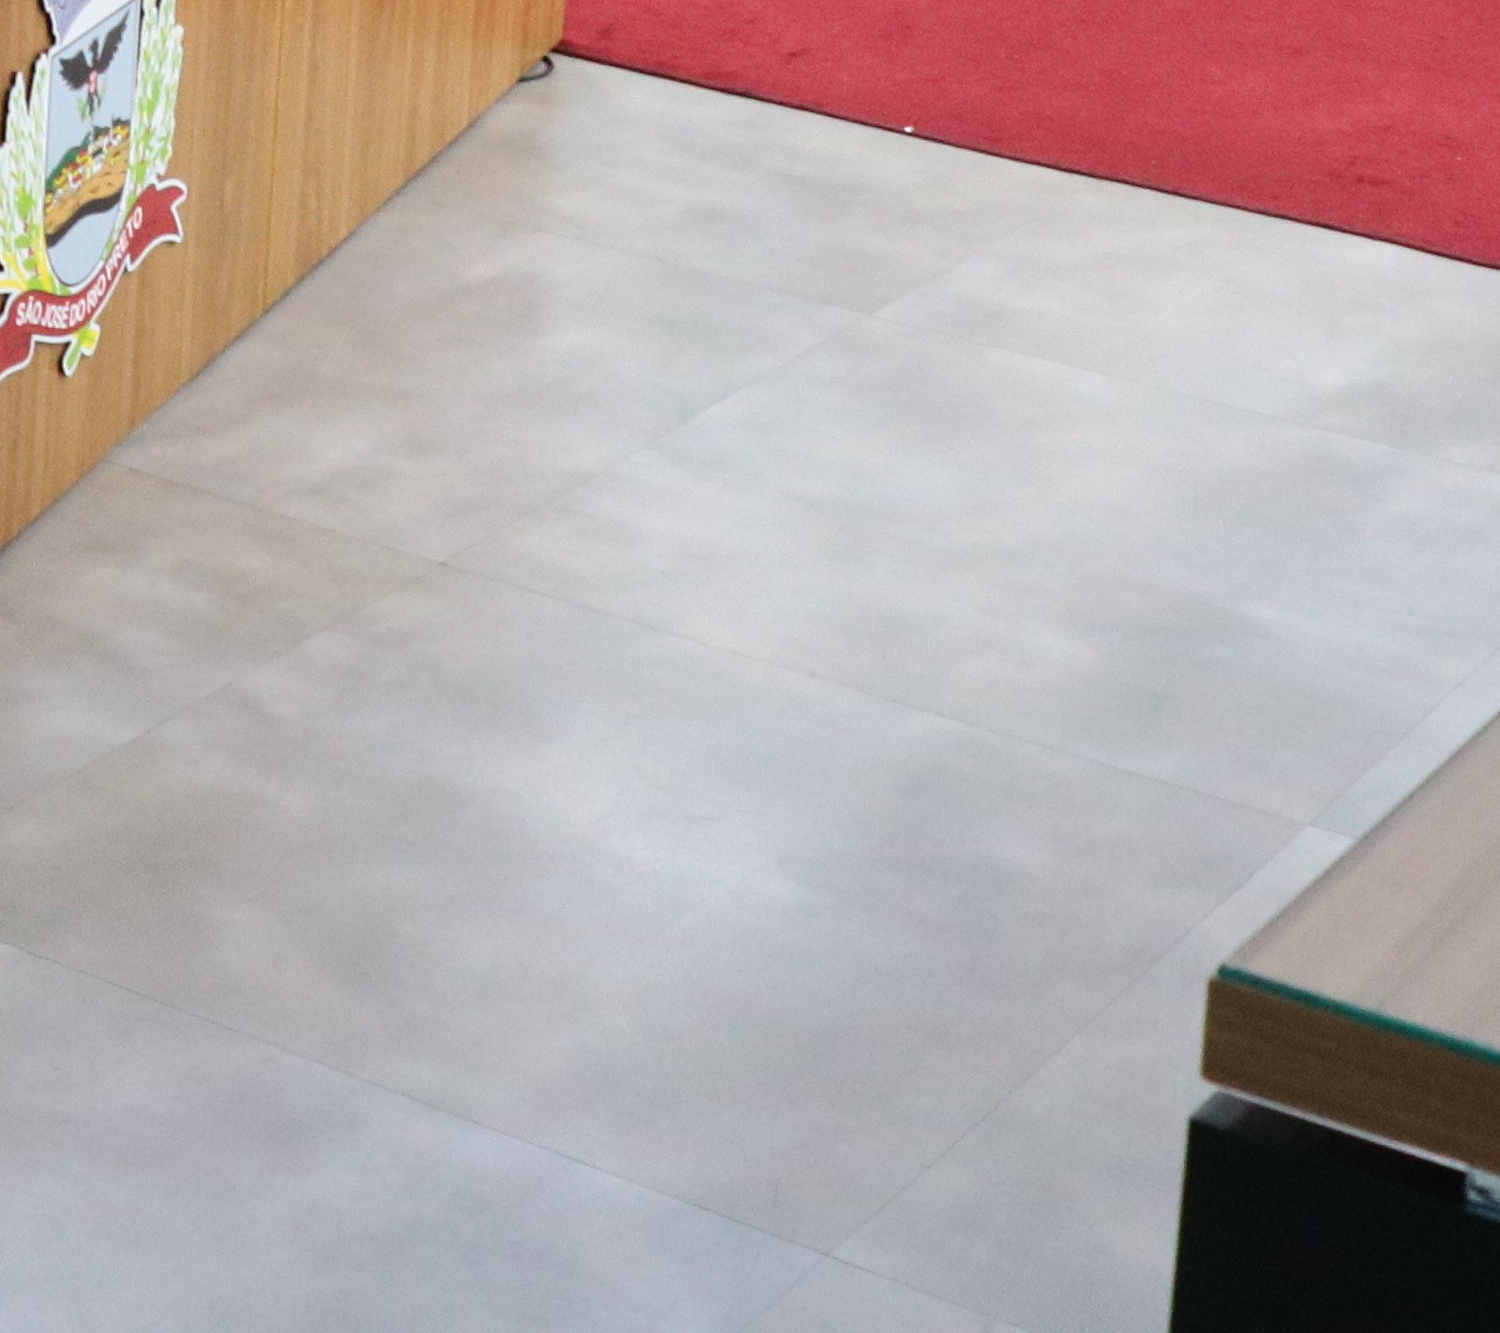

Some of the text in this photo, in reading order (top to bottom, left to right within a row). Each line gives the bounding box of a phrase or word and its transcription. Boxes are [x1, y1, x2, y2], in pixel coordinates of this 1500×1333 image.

[15, 206, 143, 330] SÃO JOSÉ DO RIO PRETO
